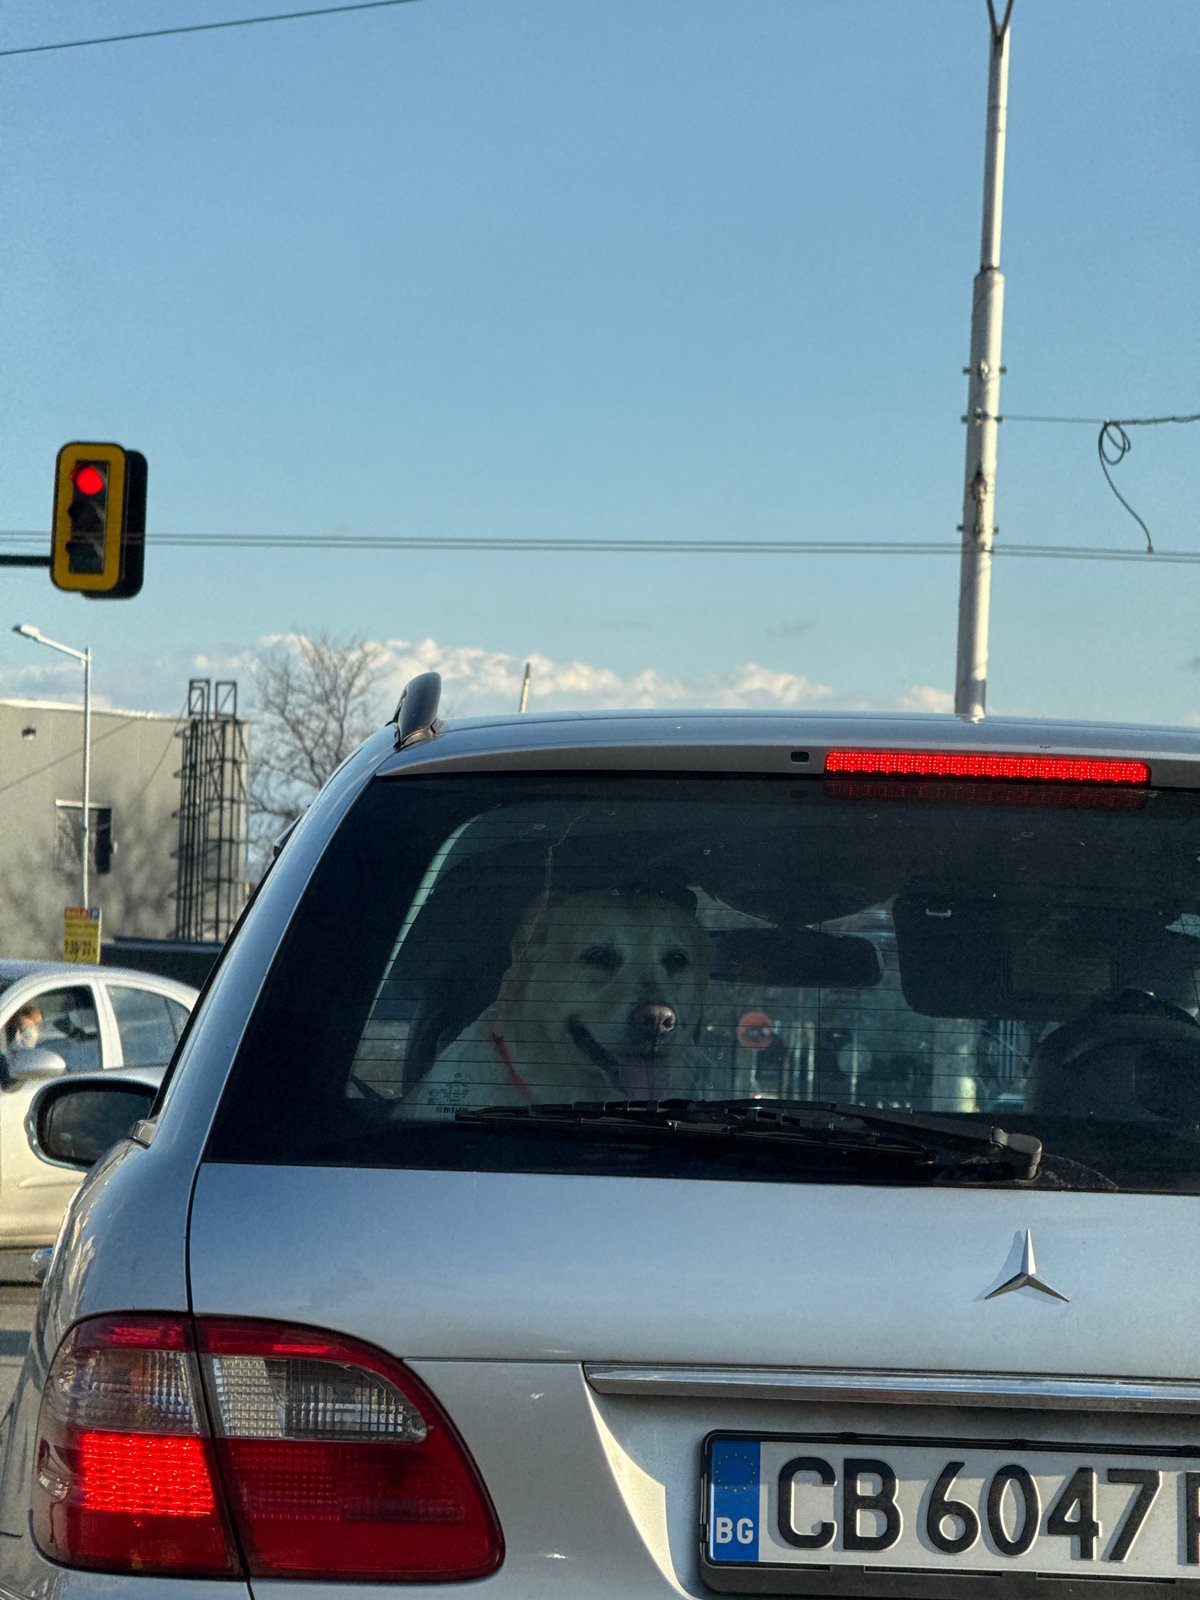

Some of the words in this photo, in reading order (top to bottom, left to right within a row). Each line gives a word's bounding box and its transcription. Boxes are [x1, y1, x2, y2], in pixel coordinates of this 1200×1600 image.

[715, 1516, 754, 1545] BG
[777, 1457, 903, 1551] CB
[926, 1461, 1163, 1562] 6047
